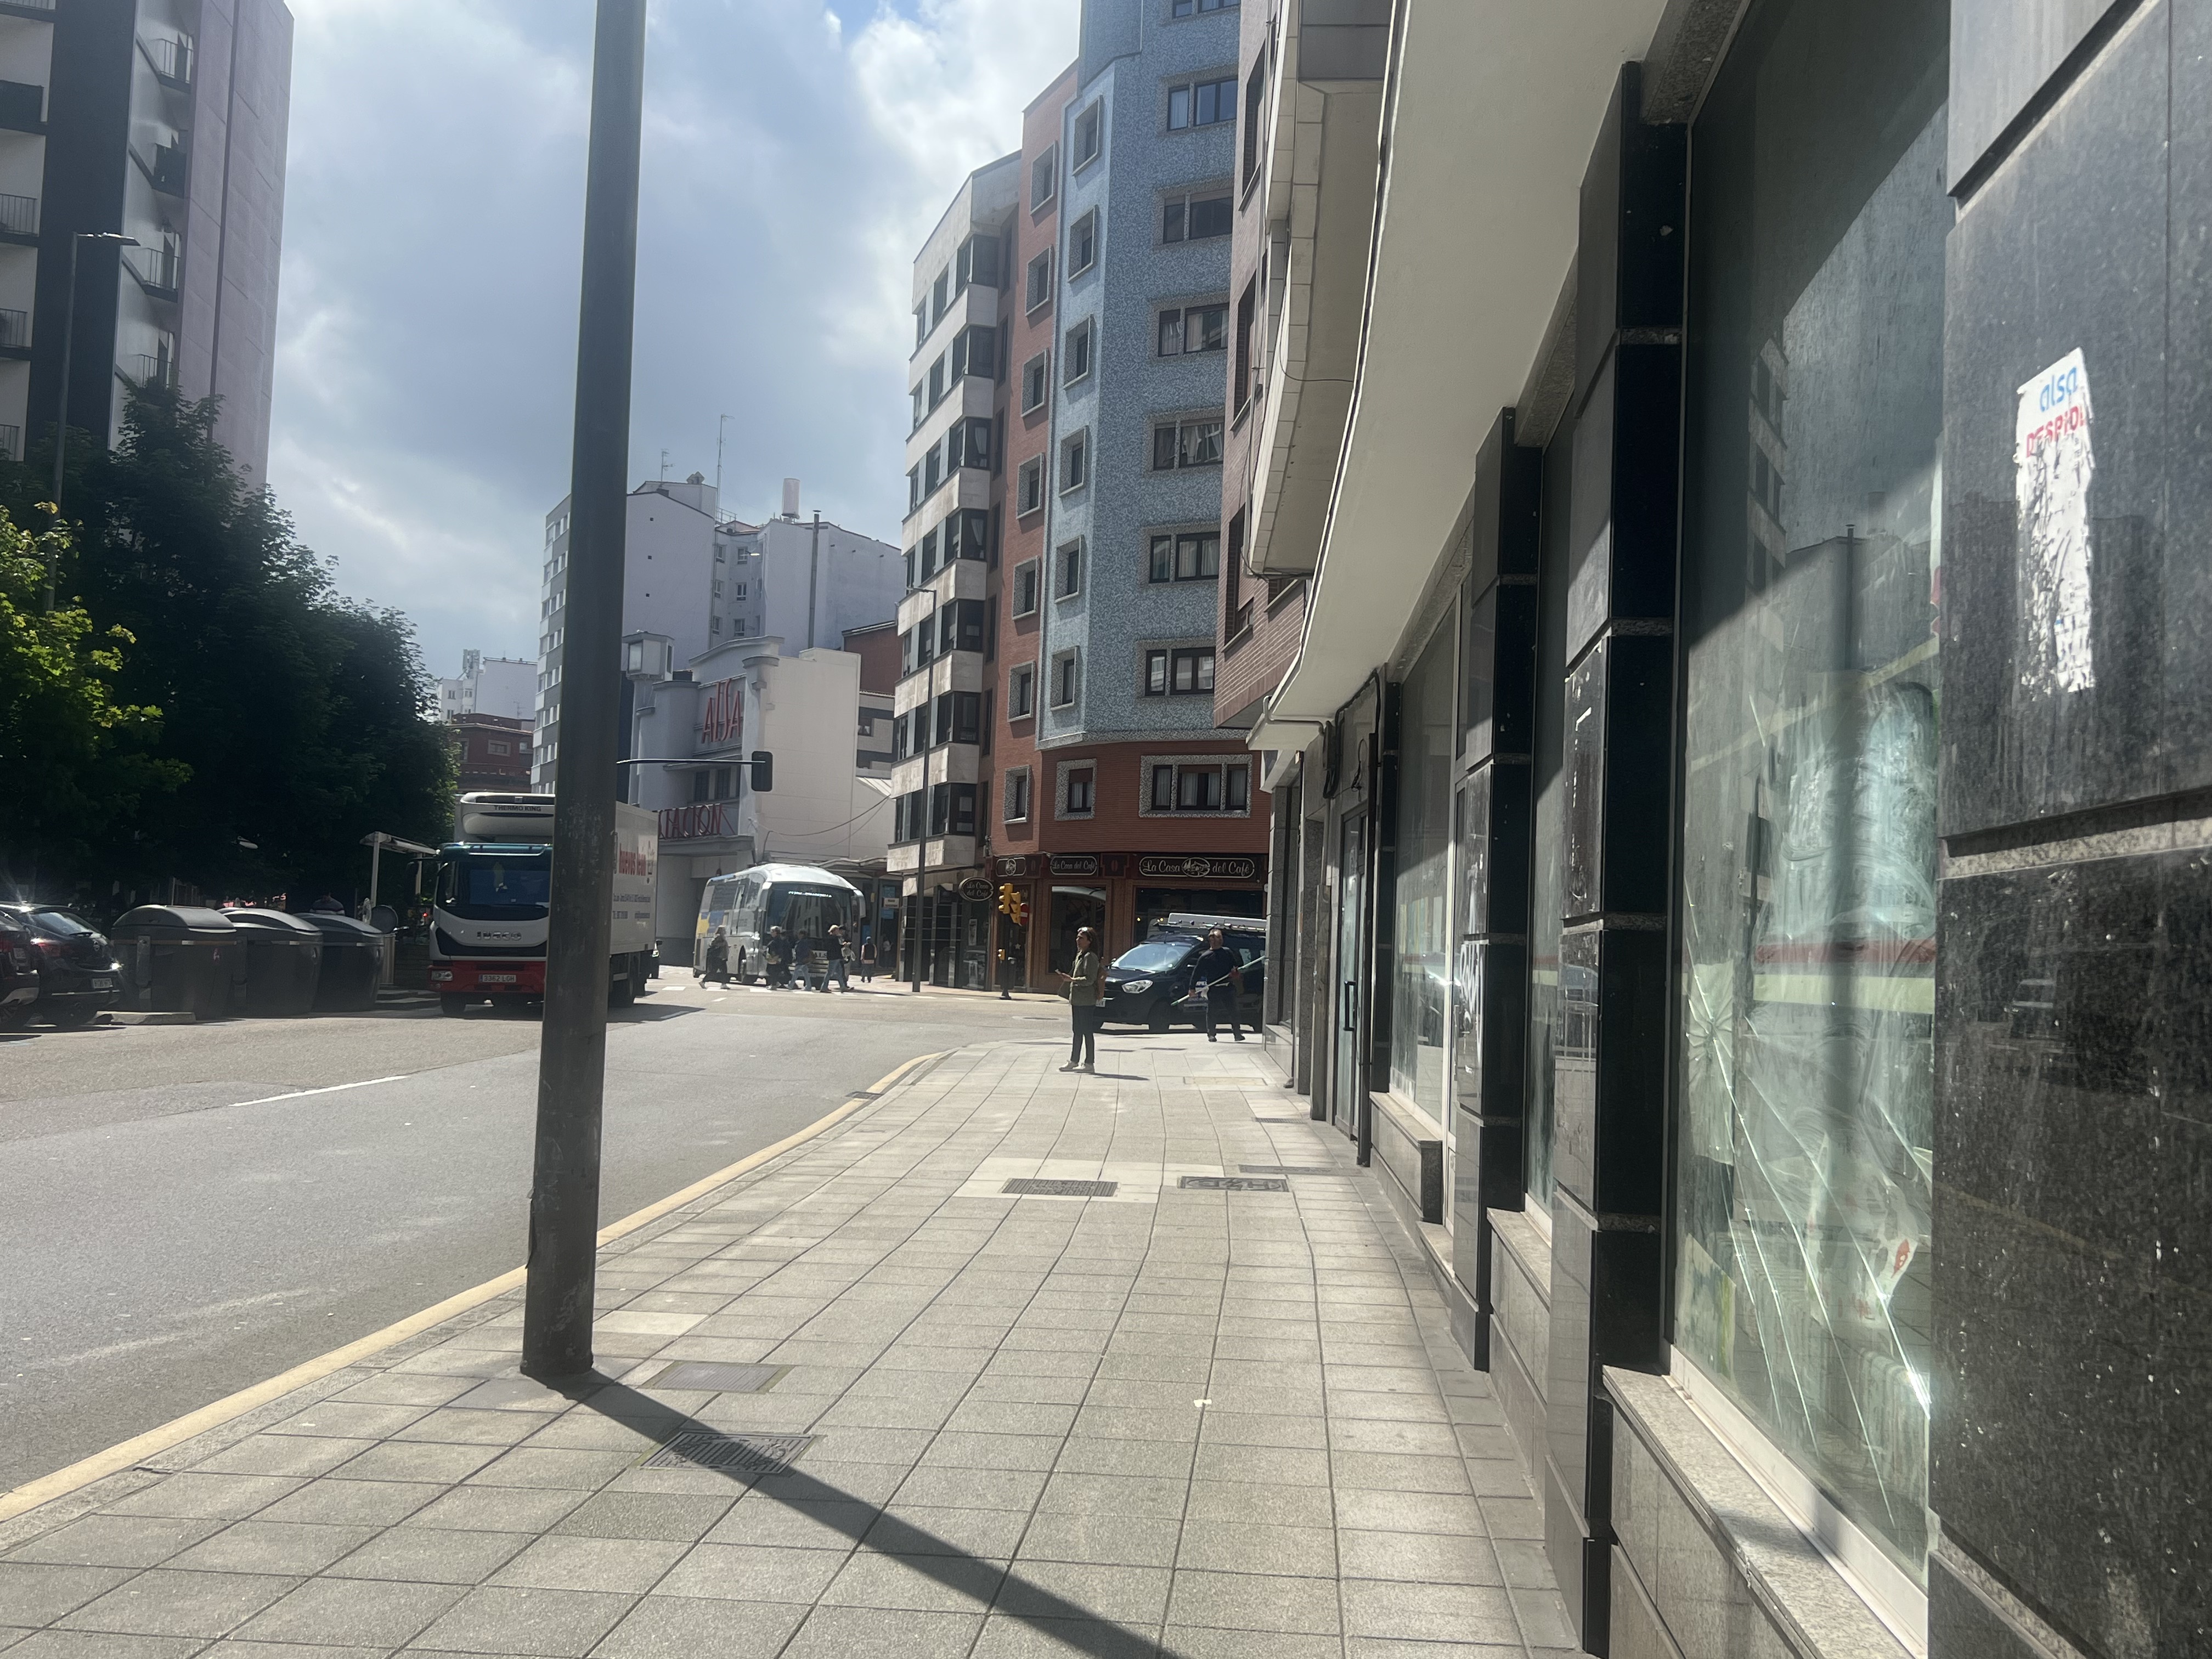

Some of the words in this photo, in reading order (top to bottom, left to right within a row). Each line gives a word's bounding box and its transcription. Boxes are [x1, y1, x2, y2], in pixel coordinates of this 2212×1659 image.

[2040, 367, 2078, 411] alsa
[702, 678, 741, 744] ALSA
[1053, 860, 1060, 869] La
[1061, 860, 1073, 870] Casa
[1074, 861, 1082, 869] del
[1084, 860, 1095, 871] Café
[1143, 860, 1156, 872] La
[1159, 860, 1180, 873] Casa
[1212, 862, 1226, 873] del
[1228, 861, 1249, 876] Café
[477, 932, 521, 940] IVECO
